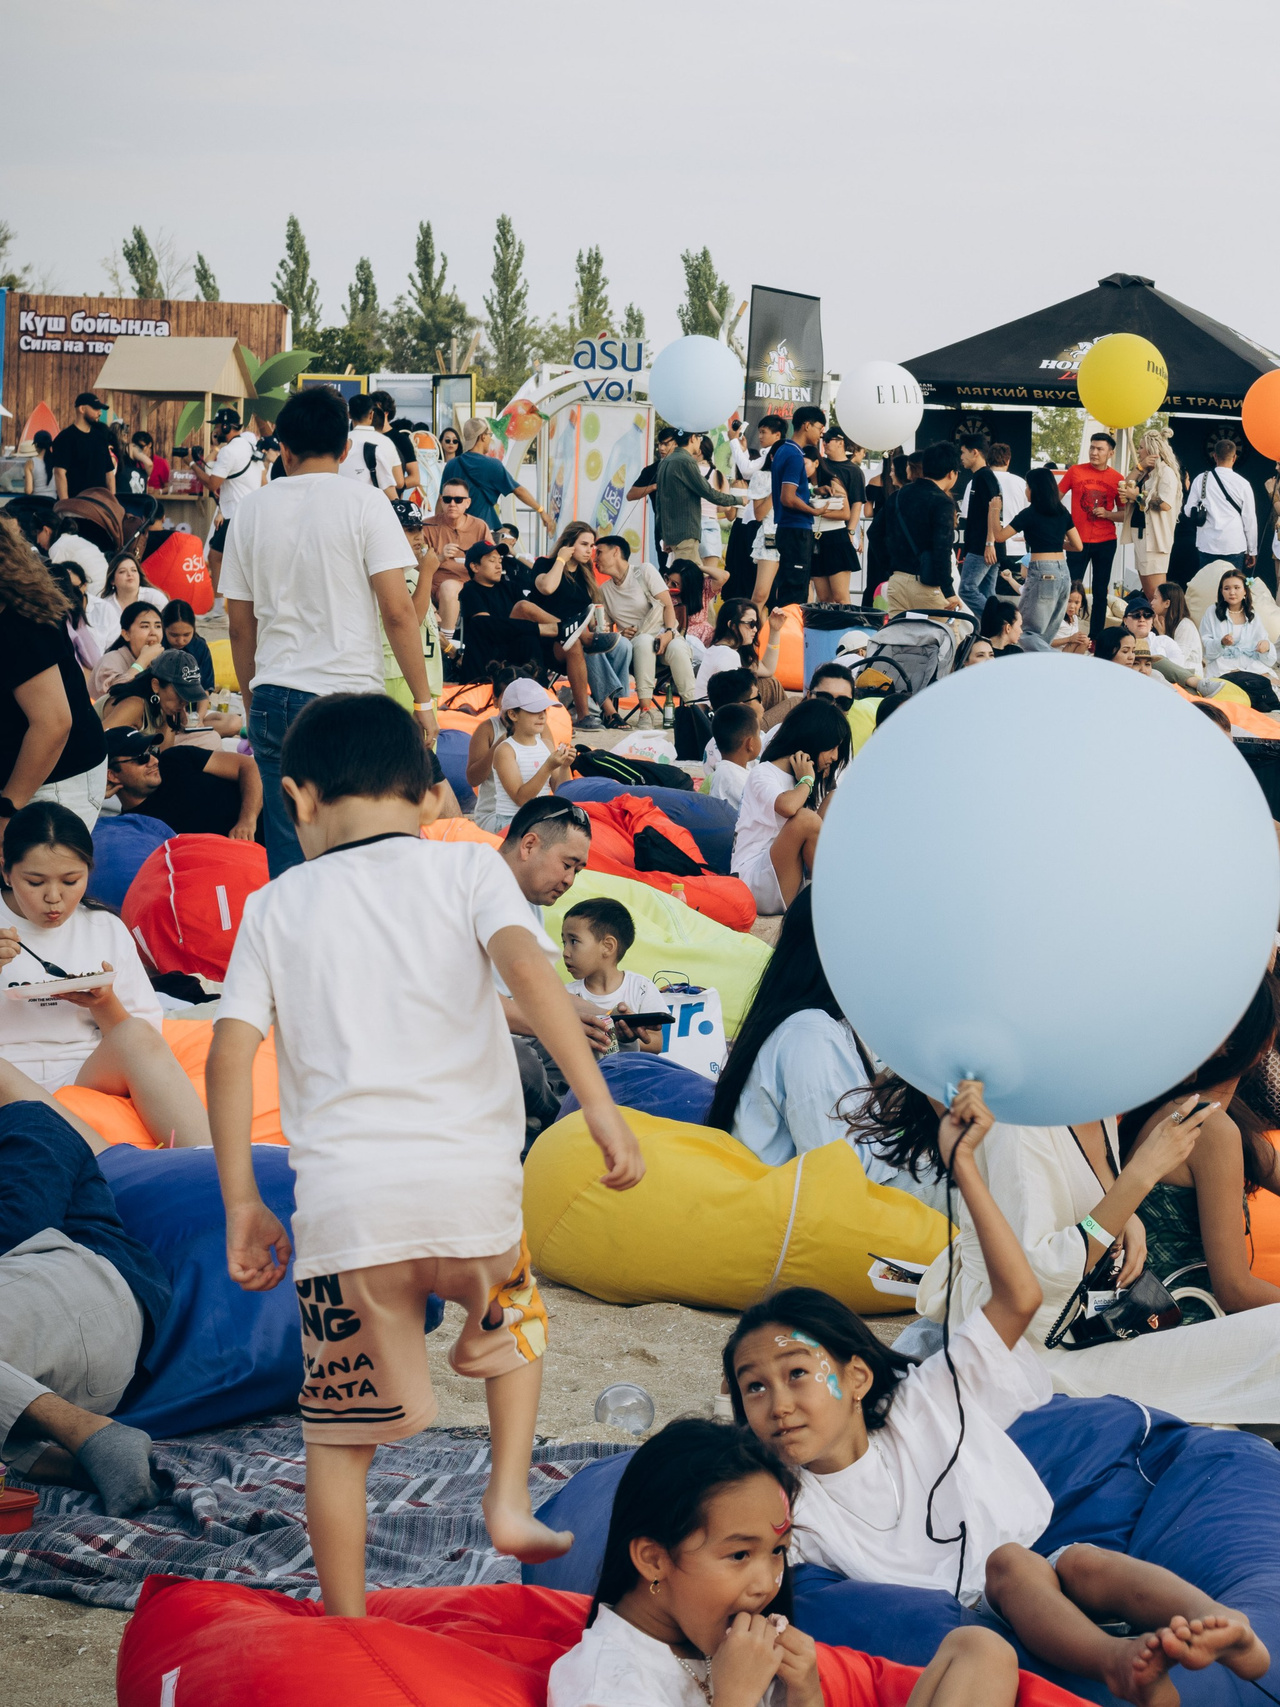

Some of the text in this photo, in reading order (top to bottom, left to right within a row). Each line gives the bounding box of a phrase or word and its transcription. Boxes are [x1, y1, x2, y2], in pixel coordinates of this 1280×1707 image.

[19, 311, 170, 337] Күш бойында
[19, 336, 114, 354] Сила на тво
[583, 376, 634, 402] vo!
[755, 381, 811, 402] HOLSTEN
[956, 386, 1028, 398] МЯГКИЙ
[1186, 396, 1244, 410] ТРАДИ
[299, 1300, 361, 1342] NG
[303, 1352, 374, 1379] KUNA
[300, 1378, 378, 1401] TATA
